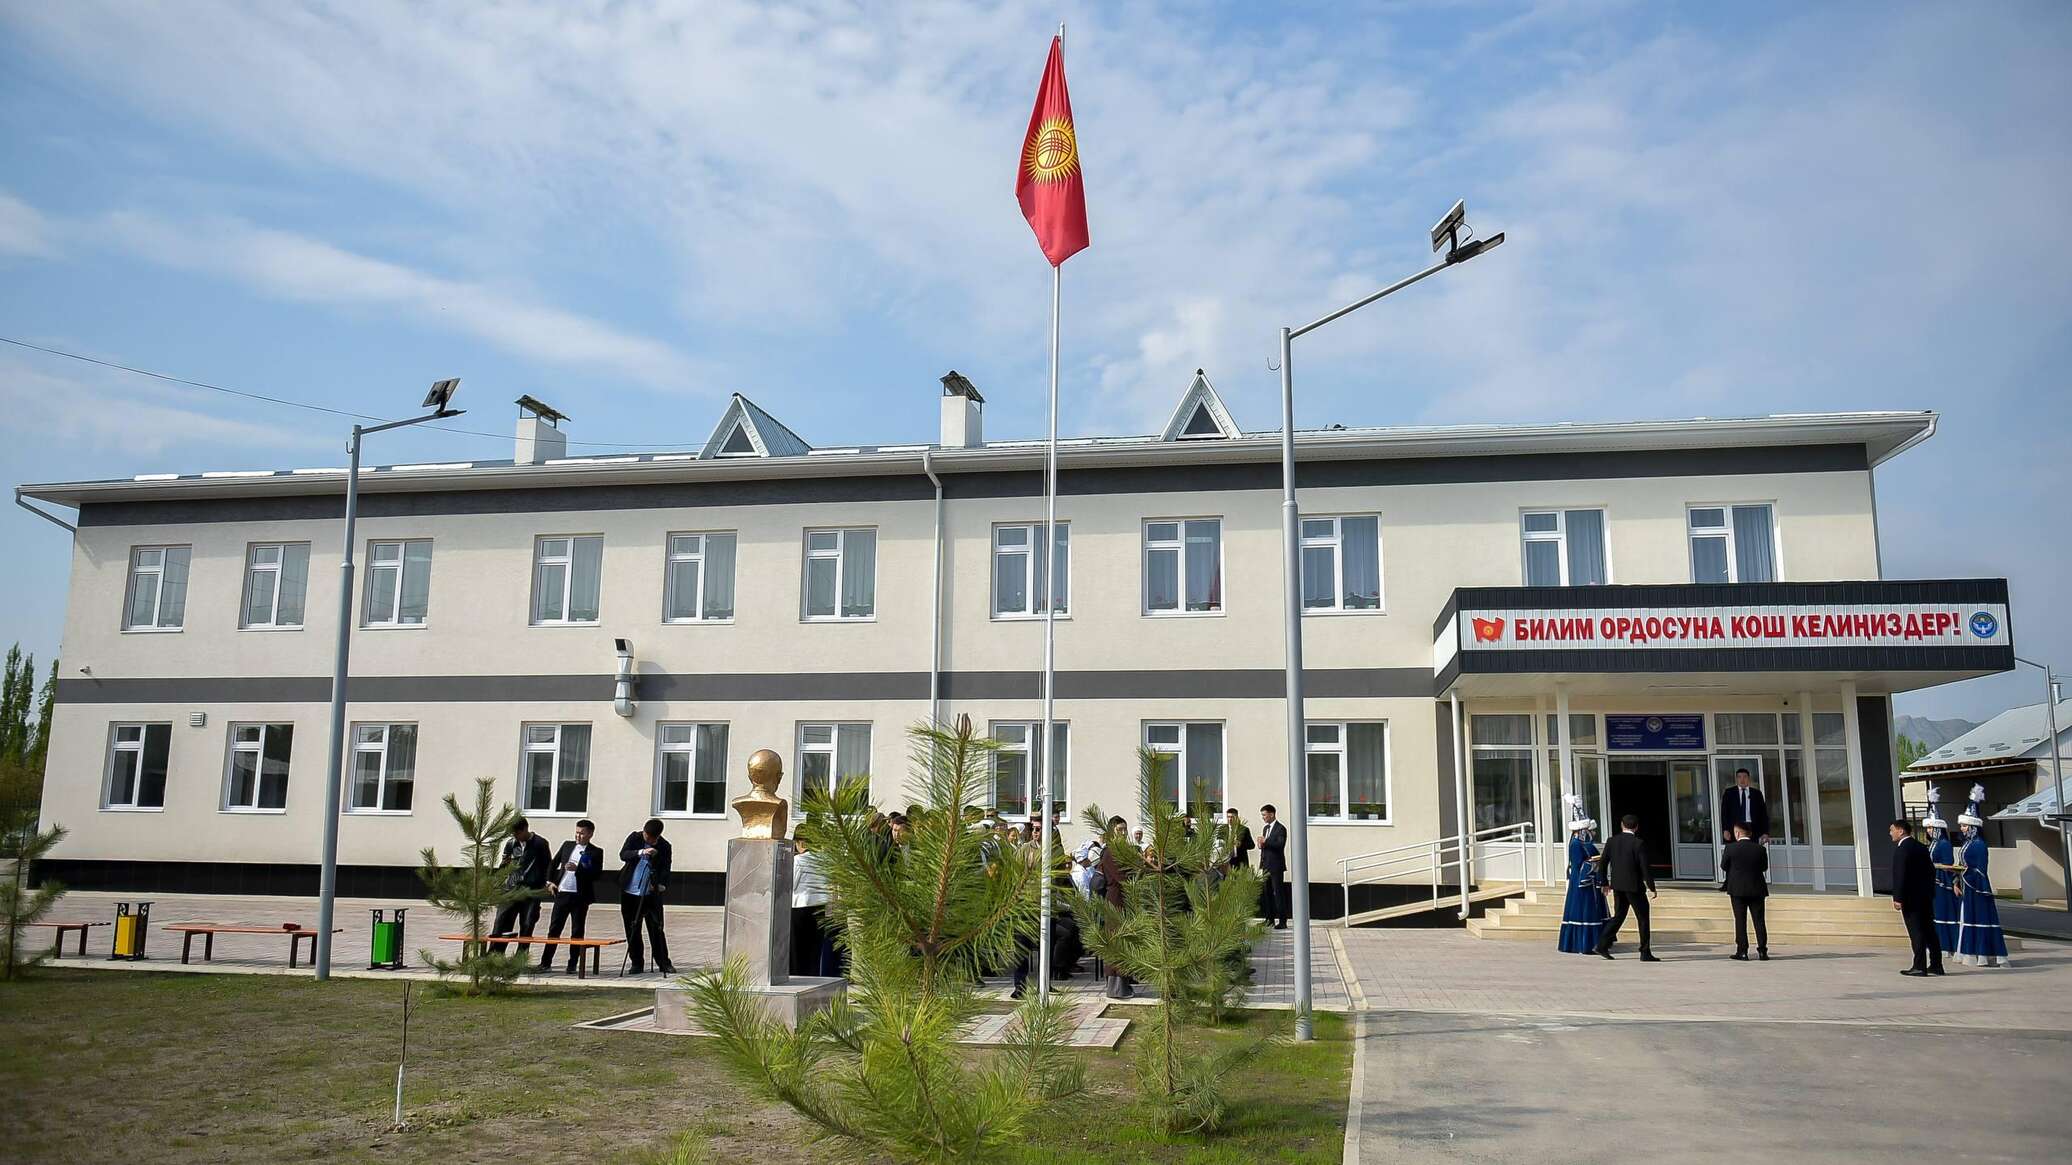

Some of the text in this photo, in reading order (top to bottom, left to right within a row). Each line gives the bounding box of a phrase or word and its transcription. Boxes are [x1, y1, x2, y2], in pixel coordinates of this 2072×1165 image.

[1515, 612, 1962, 644] БИЛИМ ОРДОСУНА КОШ КЕЛИҢИЗДЕР!
